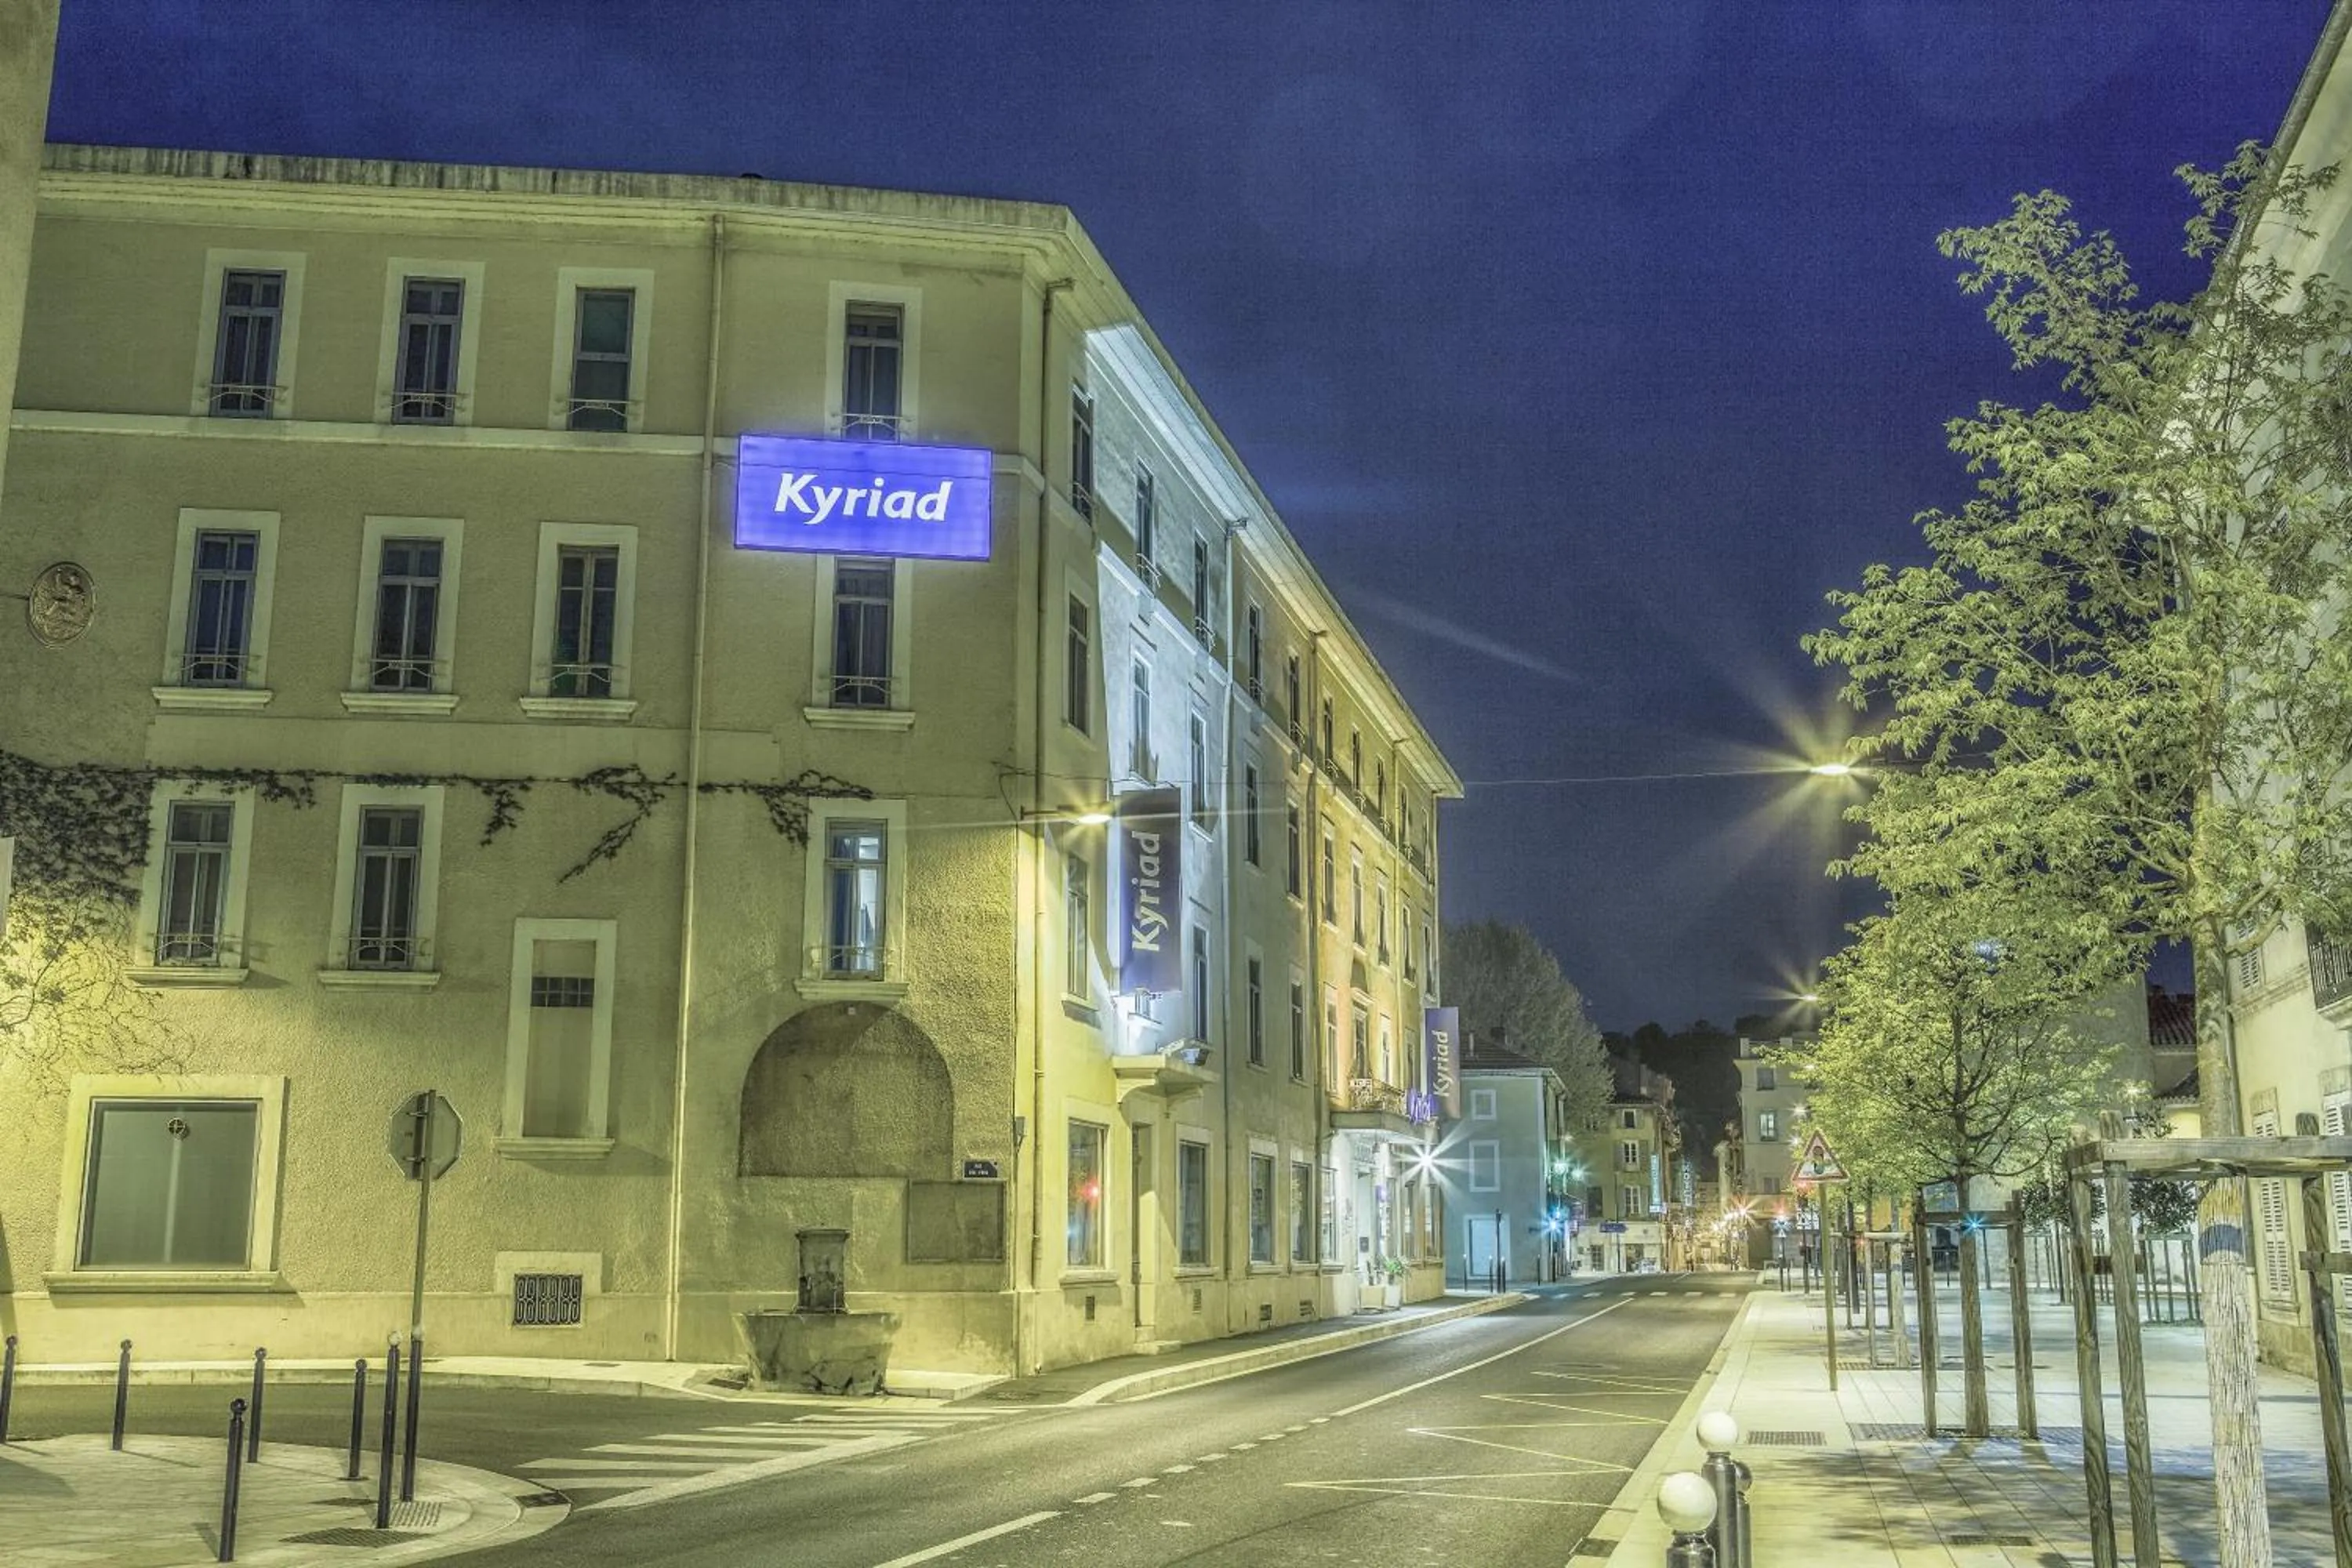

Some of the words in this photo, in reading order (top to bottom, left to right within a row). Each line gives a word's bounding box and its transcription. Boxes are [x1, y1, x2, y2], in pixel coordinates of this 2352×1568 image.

[773, 472, 953, 524] Kyriad
[1131, 829, 1168, 952] Kyriad
[1432, 1029, 1453, 1097] Kyriad
